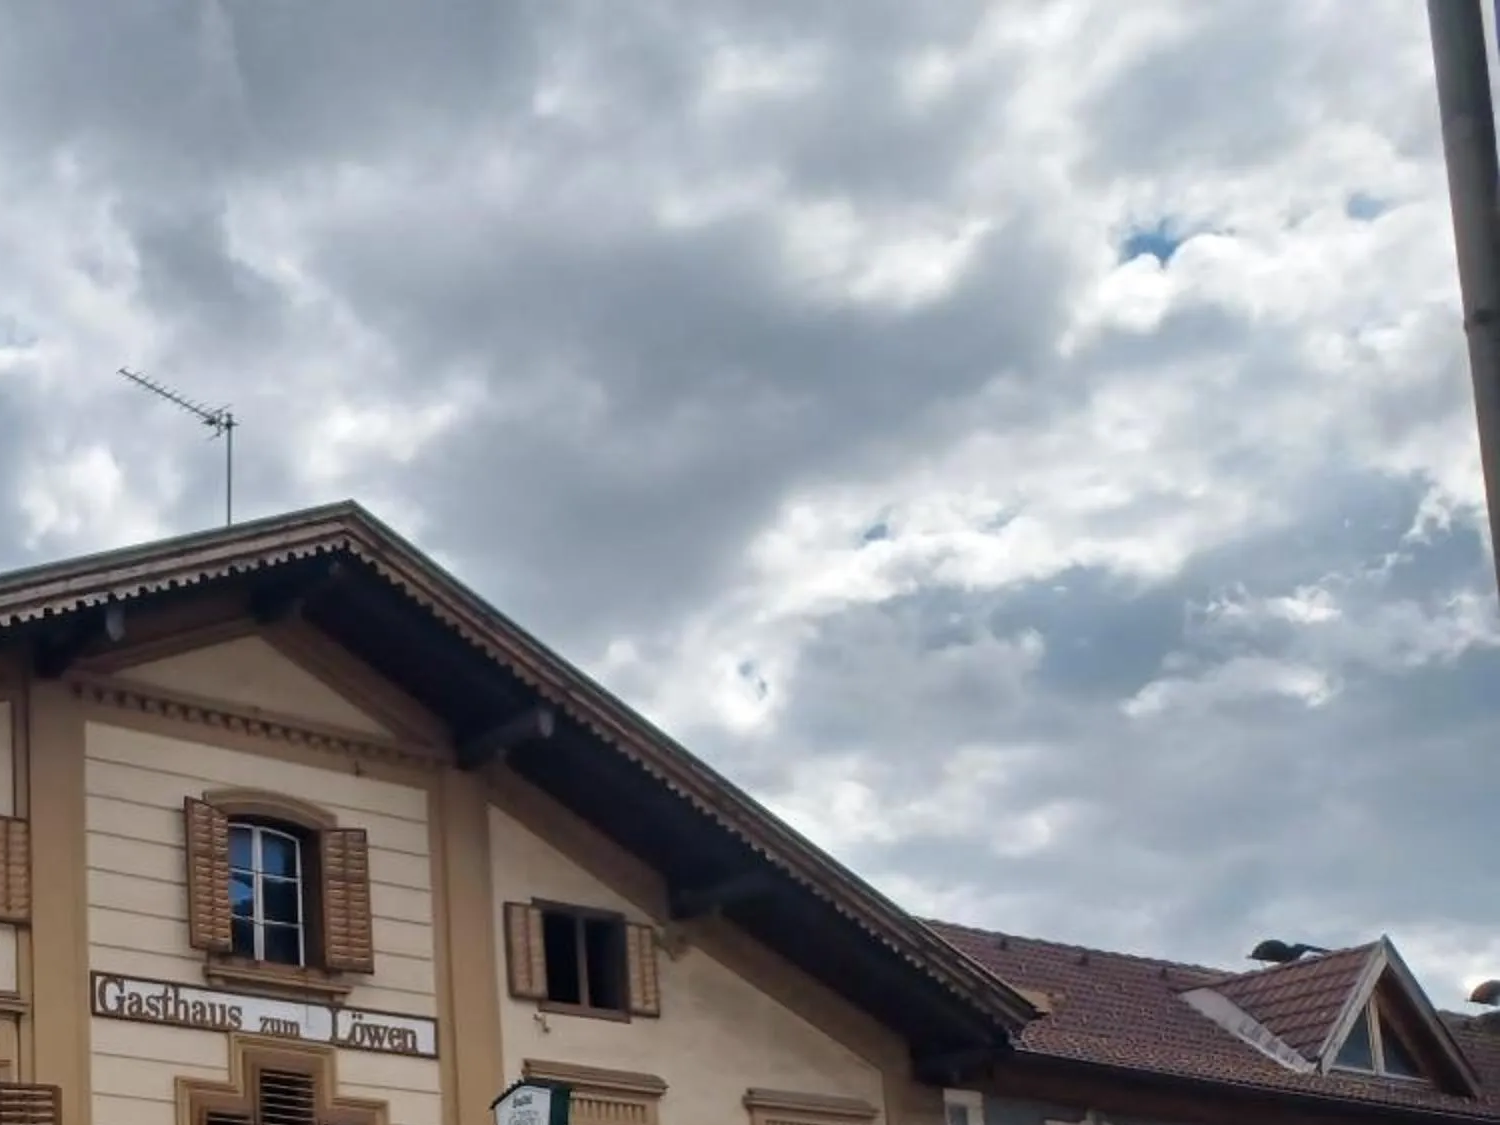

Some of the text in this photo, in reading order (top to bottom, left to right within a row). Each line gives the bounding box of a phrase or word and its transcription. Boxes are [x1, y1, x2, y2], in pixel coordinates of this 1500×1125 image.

[98, 977, 417, 1053] Gasthaus zum Löwen
